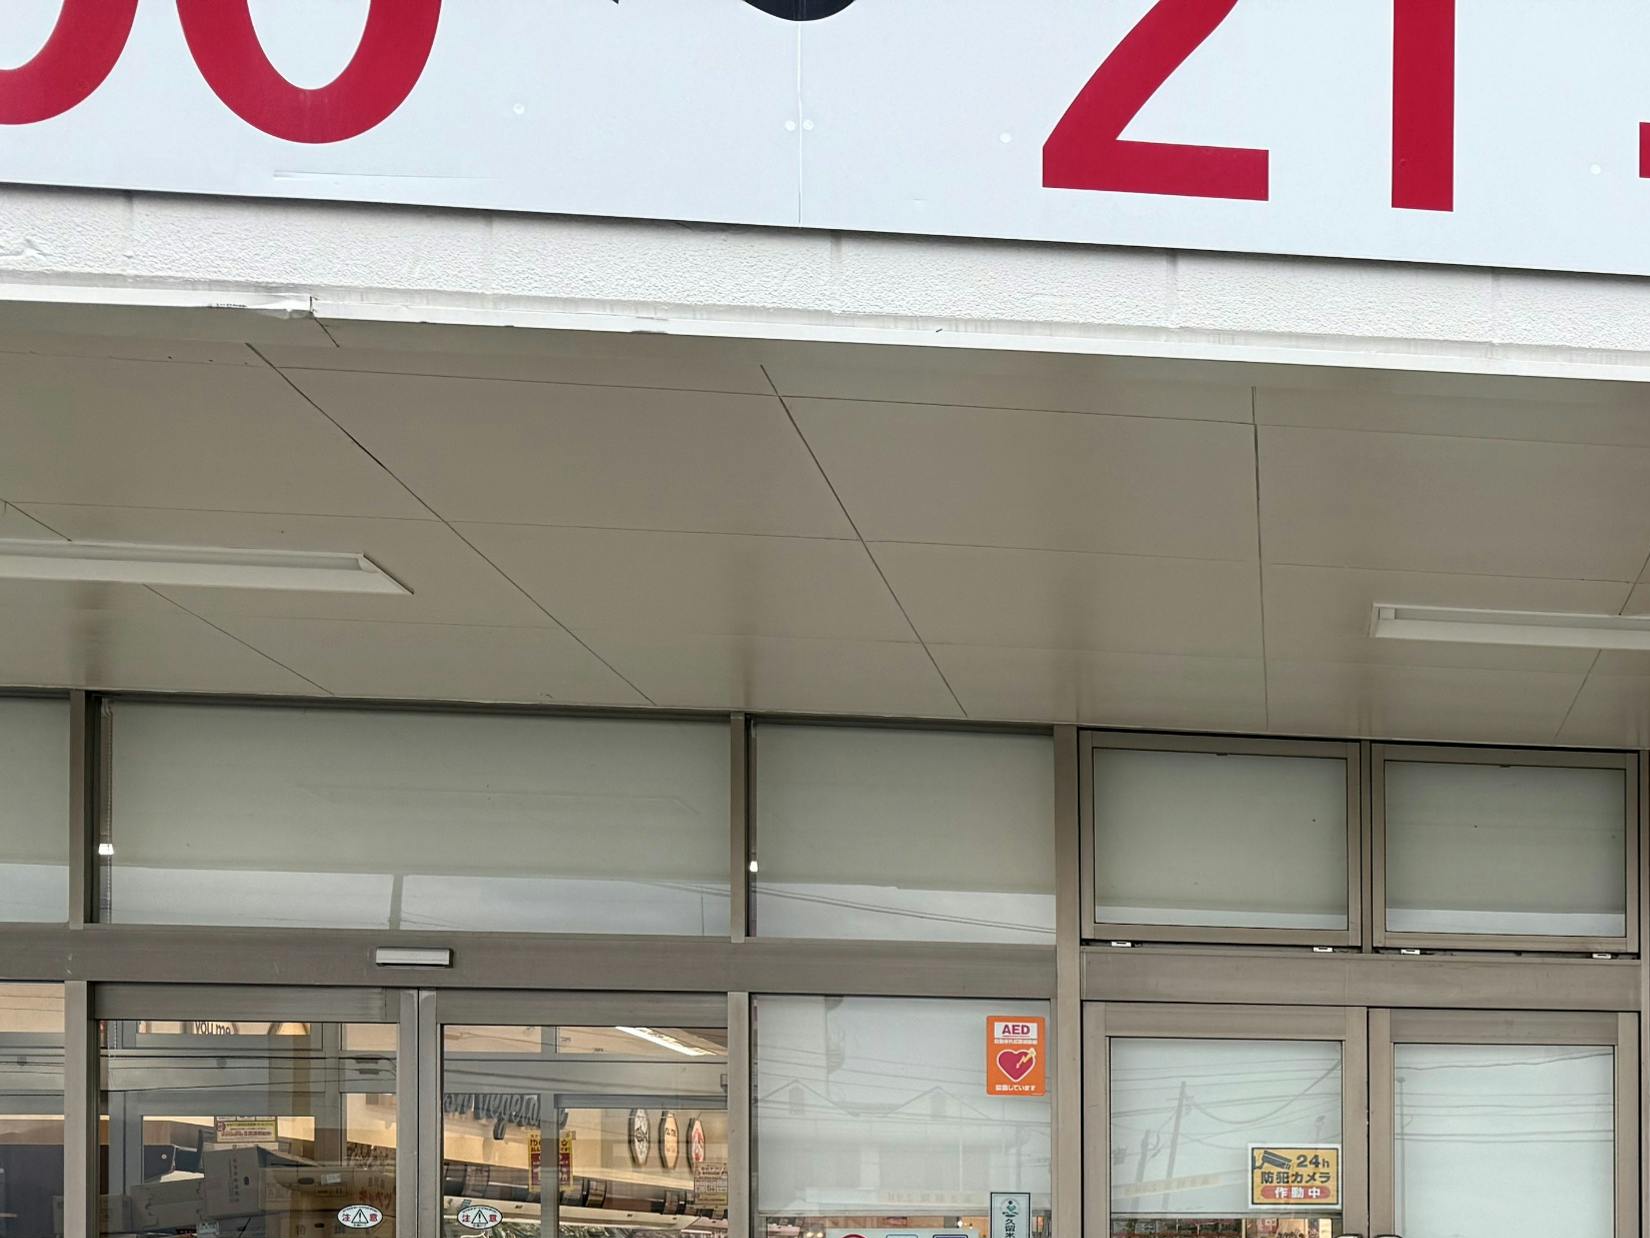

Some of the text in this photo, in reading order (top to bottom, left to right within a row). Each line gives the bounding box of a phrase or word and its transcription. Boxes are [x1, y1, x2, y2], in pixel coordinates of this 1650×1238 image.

[1002, 1024, 1030, 1035] AED
[1296, 1154, 1330, 1168] 24h
[1260, 1171, 1331, 1184] 防犯カメラ
[1274, 1186, 1321, 1199] 作動中
